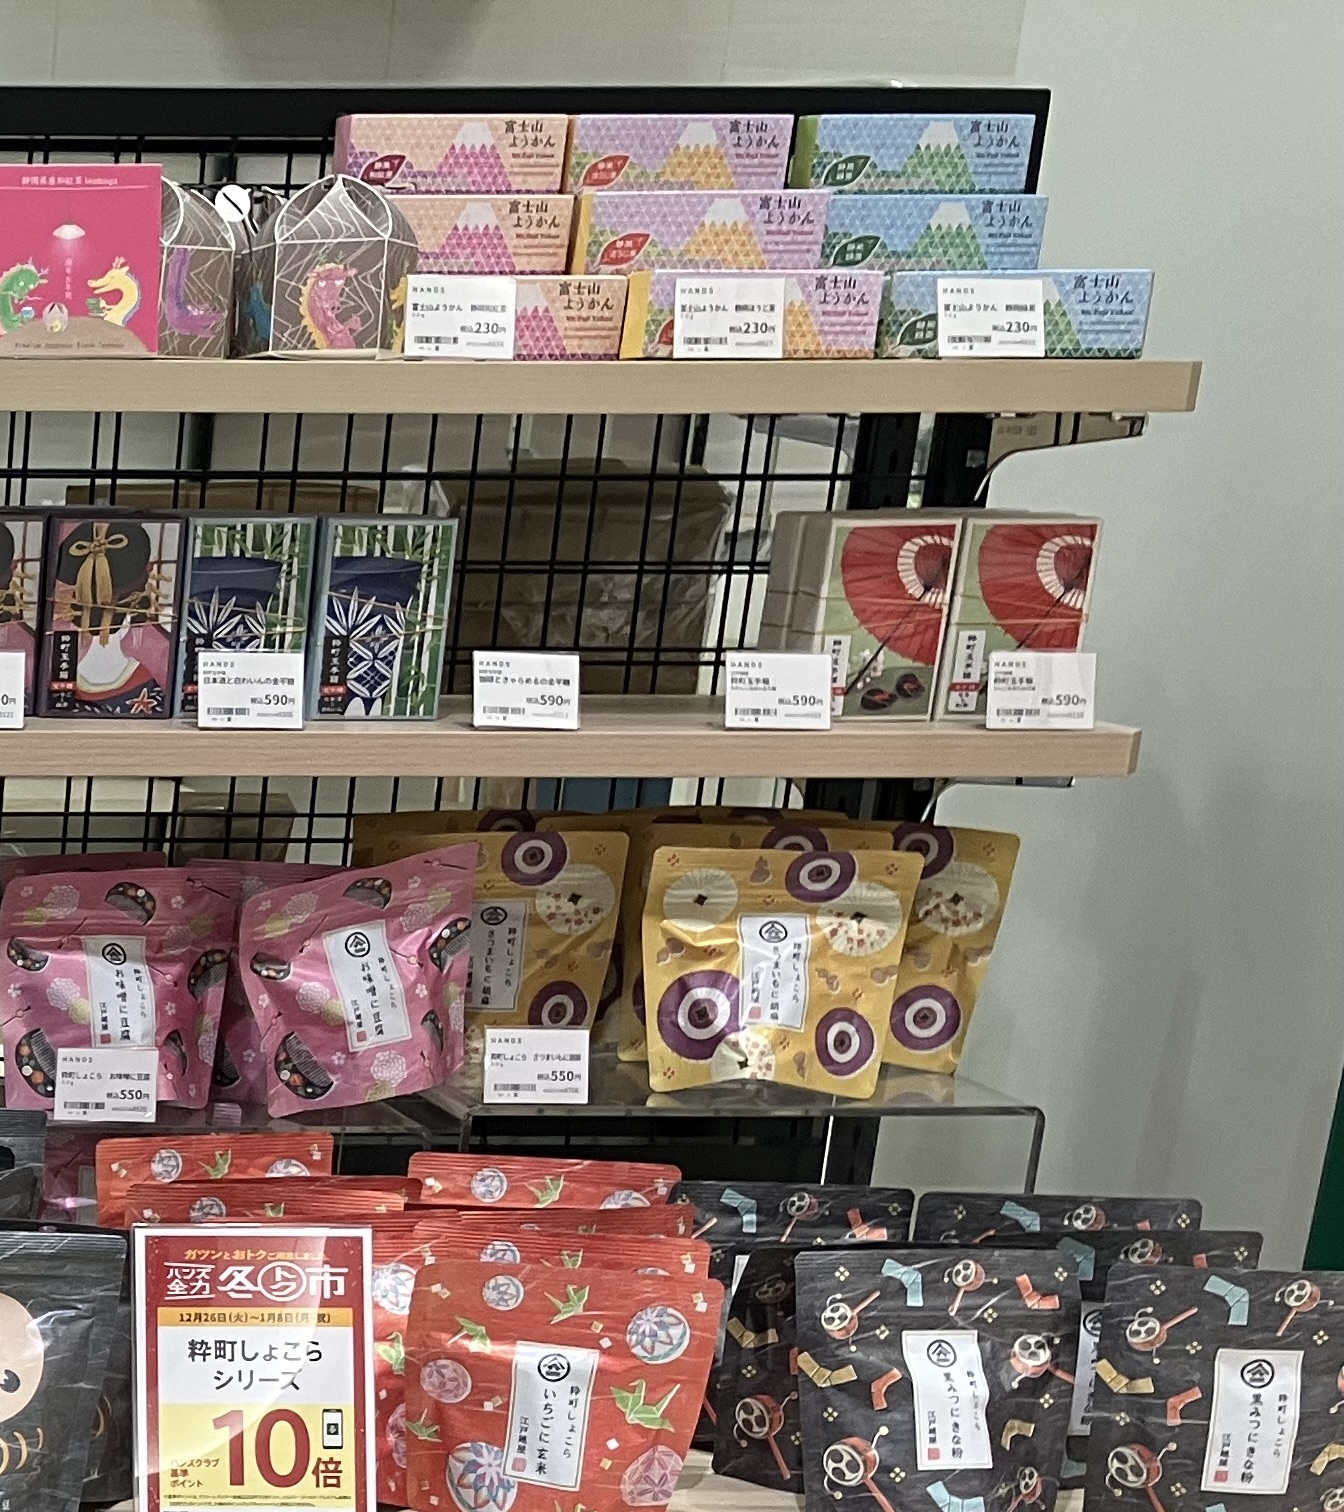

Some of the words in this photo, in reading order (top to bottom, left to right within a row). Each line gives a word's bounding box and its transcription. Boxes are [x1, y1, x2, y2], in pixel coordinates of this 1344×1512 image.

[166, 1268, 210, 1279] ハンズ
[166, 1280, 210, 1295] 全力
[188, 1339, 323, 1362] 粋町しょこら
[213, 1368, 301, 1390] シリーズ
[170, 1479, 203, 1488] ポイント
